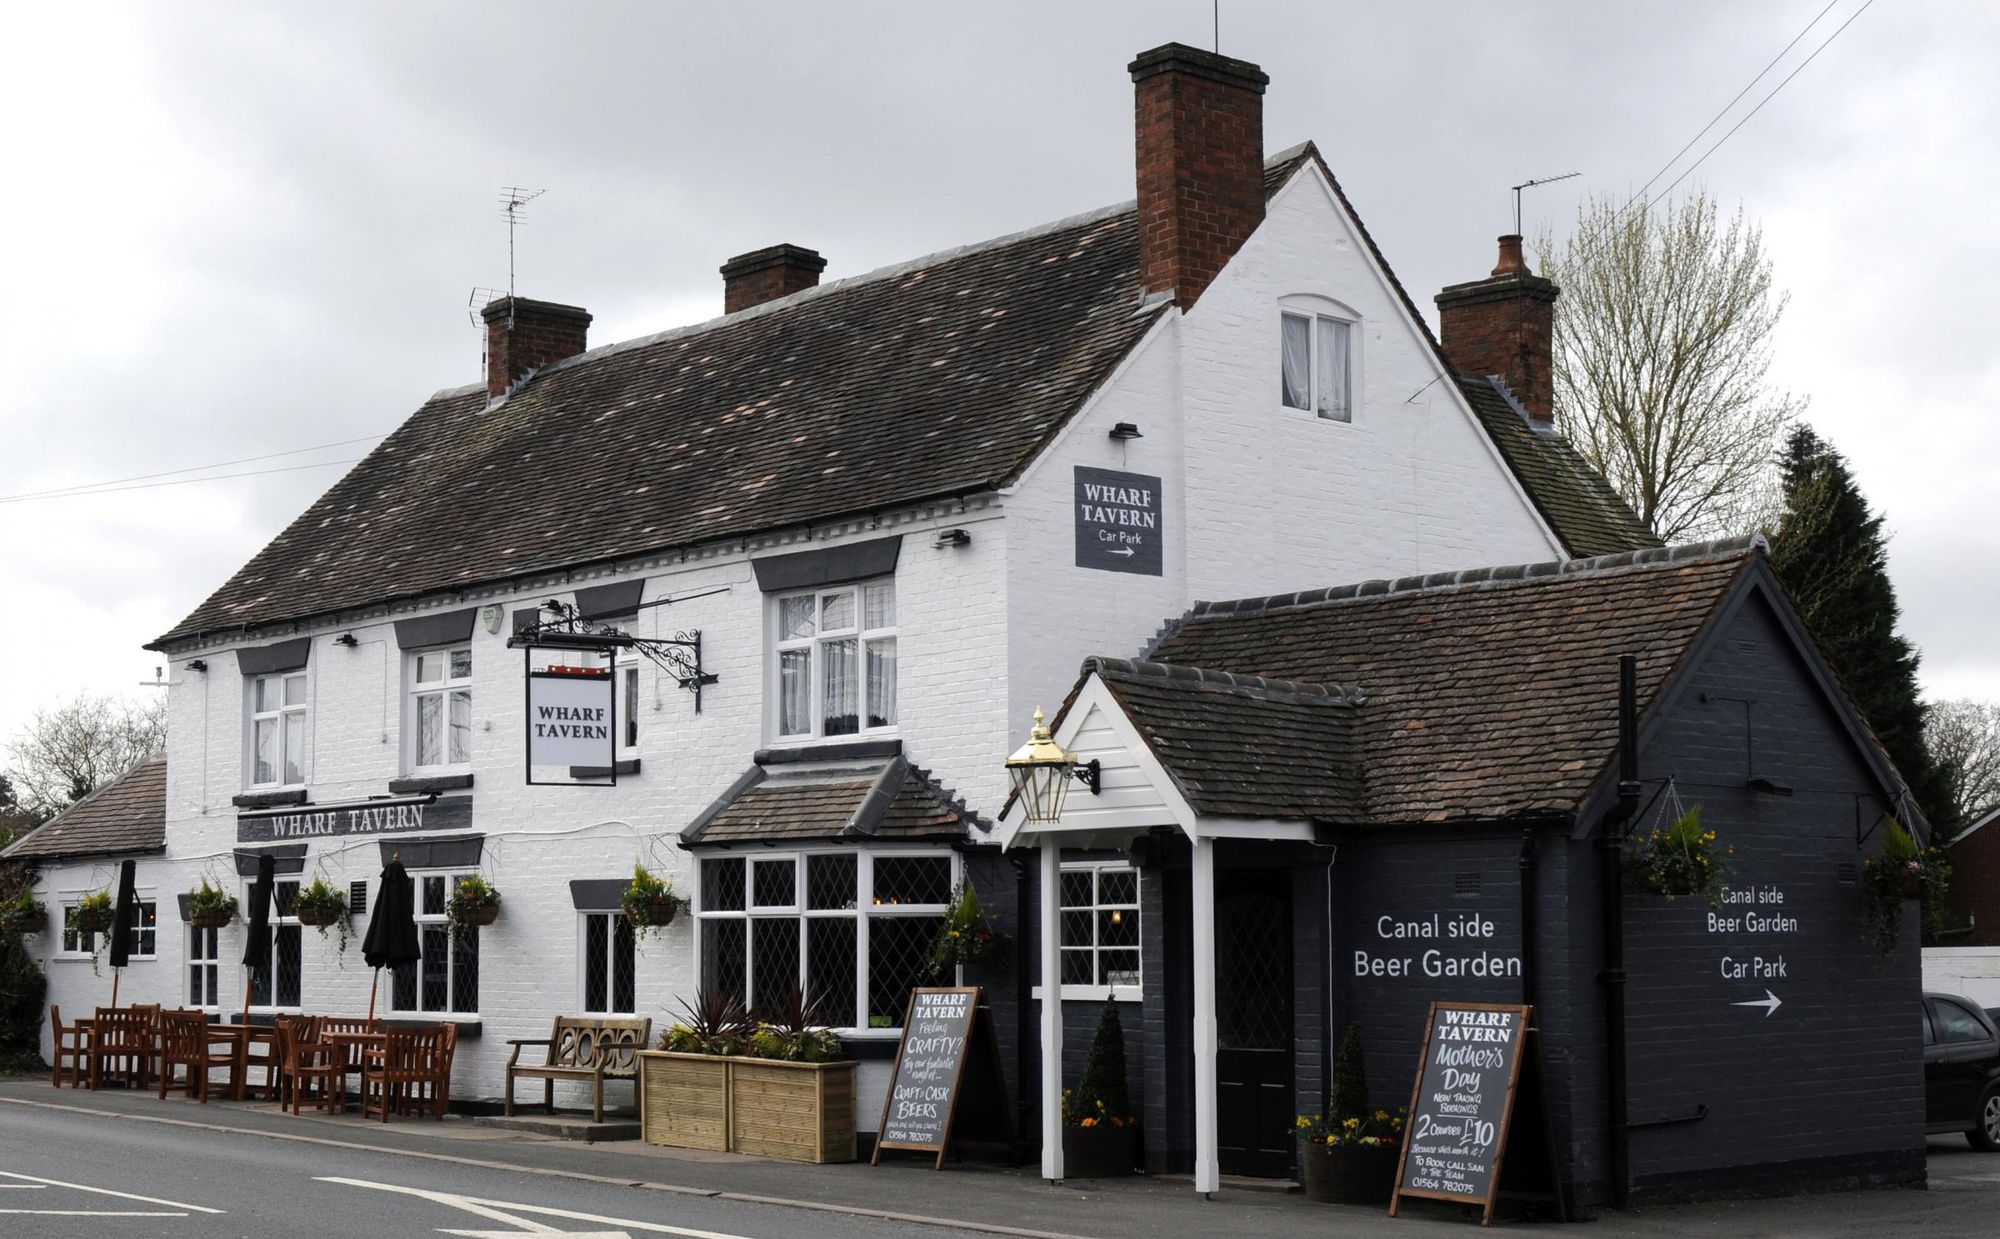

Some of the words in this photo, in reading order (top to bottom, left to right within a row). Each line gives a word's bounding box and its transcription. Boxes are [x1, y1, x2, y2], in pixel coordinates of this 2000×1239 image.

[1084, 484, 1151, 507] WHARF
[1082, 504, 1156, 528] TAVERN
[1099, 529, 1117, 542] Car
[1120, 531, 1142, 544] Park
[538, 706, 604, 721] WHARF
[536, 724, 607, 739] TAVERN
[272, 812, 336, 837] WHARF
[349, 804, 424, 833] TAVERN
[1721, 886, 1755, 903] Canal
[1759, 886, 1784, 903] side
[1378, 913, 1439, 938] Canal
[1448, 913, 1494, 937] side
[1708, 912, 1741, 932] Beer
[1746, 911, 1798, 932] Garden
[1355, 951, 1412, 976] Beer
[1422, 949, 1521, 977] Garden
[1721, 956, 1748, 978] Car
[1754, 955, 1787, 978] Park
[922, 994, 967, 1005] WHARF
[916, 1006, 967, 1018] TAVERN
[1445, 1011, 1511, 1026] WHARF
[919, 1020, 948, 1037] Feeling
[1438, 1025, 1512, 1042] TAVERN
[1436, 1043, 1503, 1069] Mother's
[1441, 1068, 1481, 1093] Day
[897, 1101, 938, 1119] BEERS
[889, 1131, 907, 1140] 01564
[909, 1132, 932, 1142] 782075
[1416, 1114, 1431, 1139] 2
[1459, 1118, 1494, 1146] £10
[1444, 1169, 1464, 1179] TEAM
[1413, 1176, 1438, 1189] 01564
[1443, 1180, 1474, 1193] 782075
